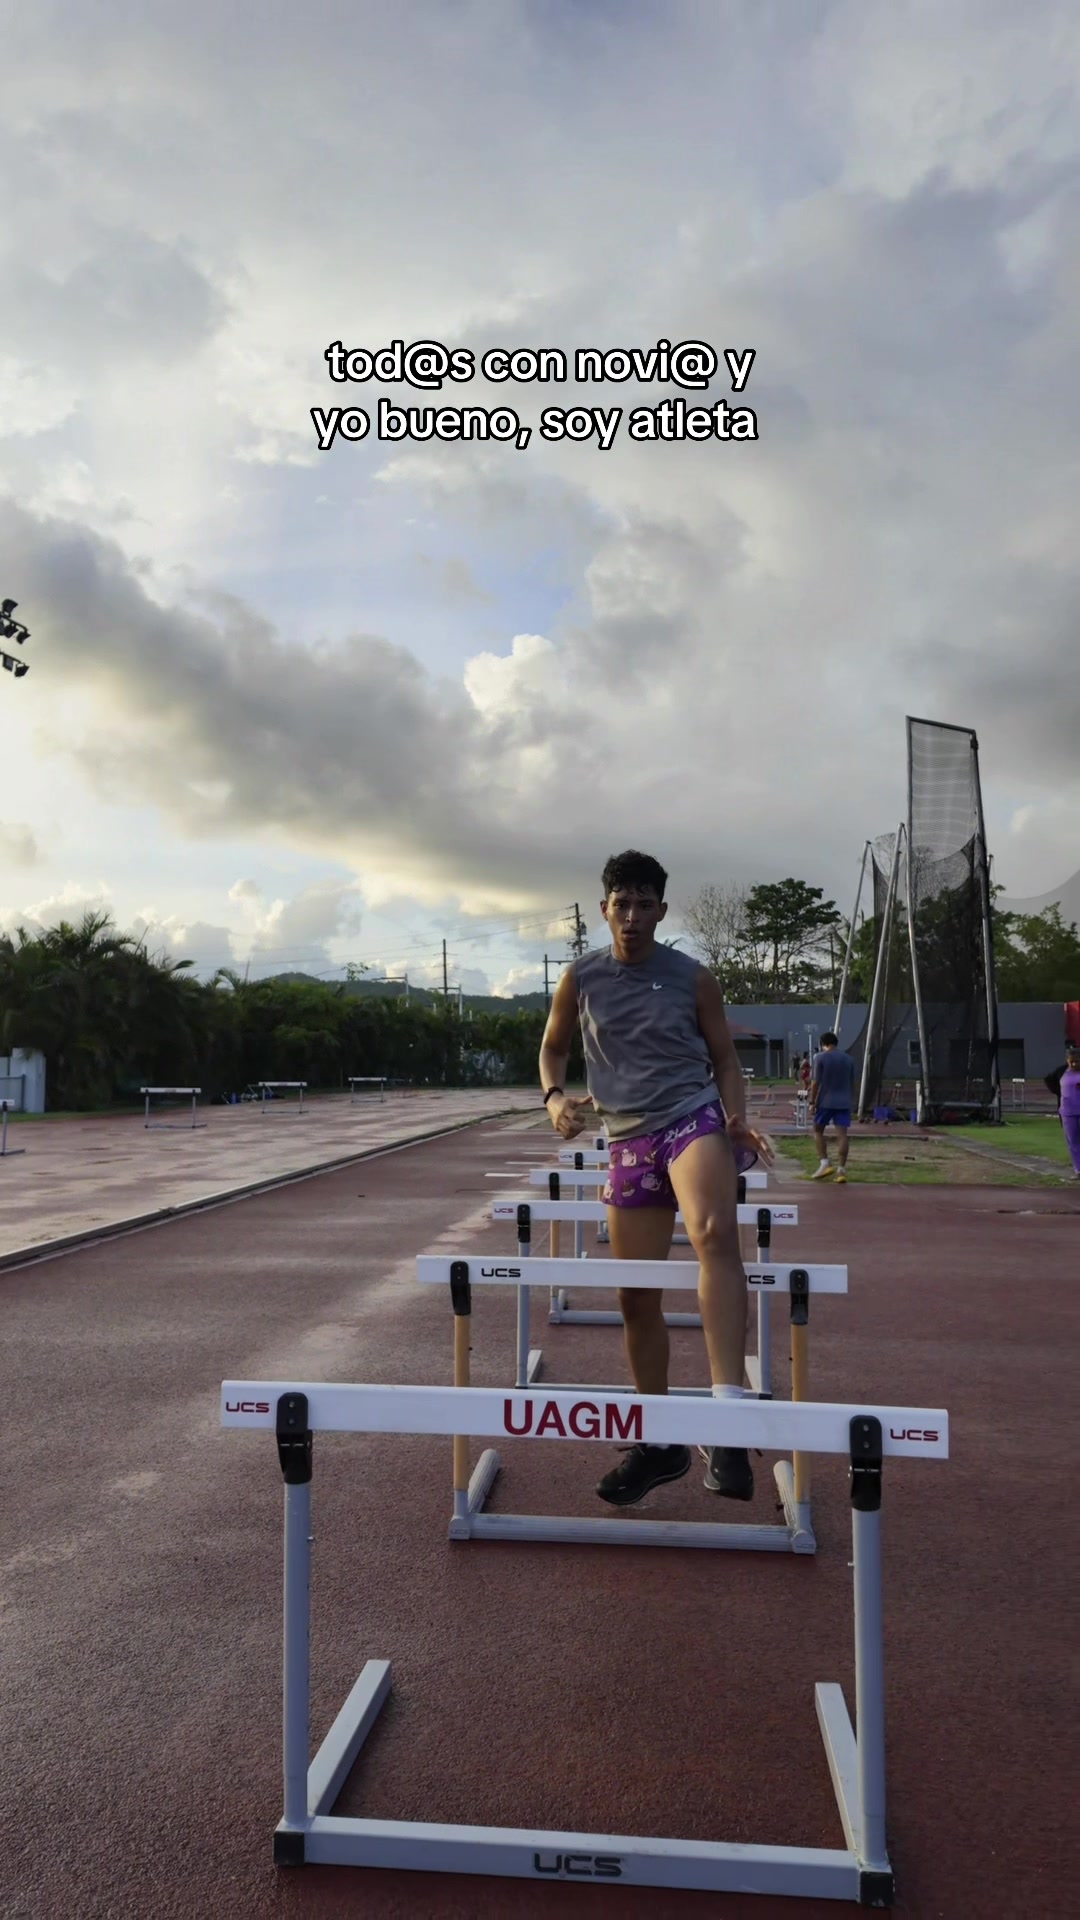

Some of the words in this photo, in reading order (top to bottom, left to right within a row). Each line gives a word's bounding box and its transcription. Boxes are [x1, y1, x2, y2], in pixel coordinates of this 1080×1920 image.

[481, 1267, 521, 1278] UCS
[745, 1274, 776, 1285] CS
[225, 1401, 270, 1413] UCS
[503, 1398, 644, 1441] UAGM
[889, 1428, 939, 1442] UCS
[533, 1852, 622, 1877] UCS
